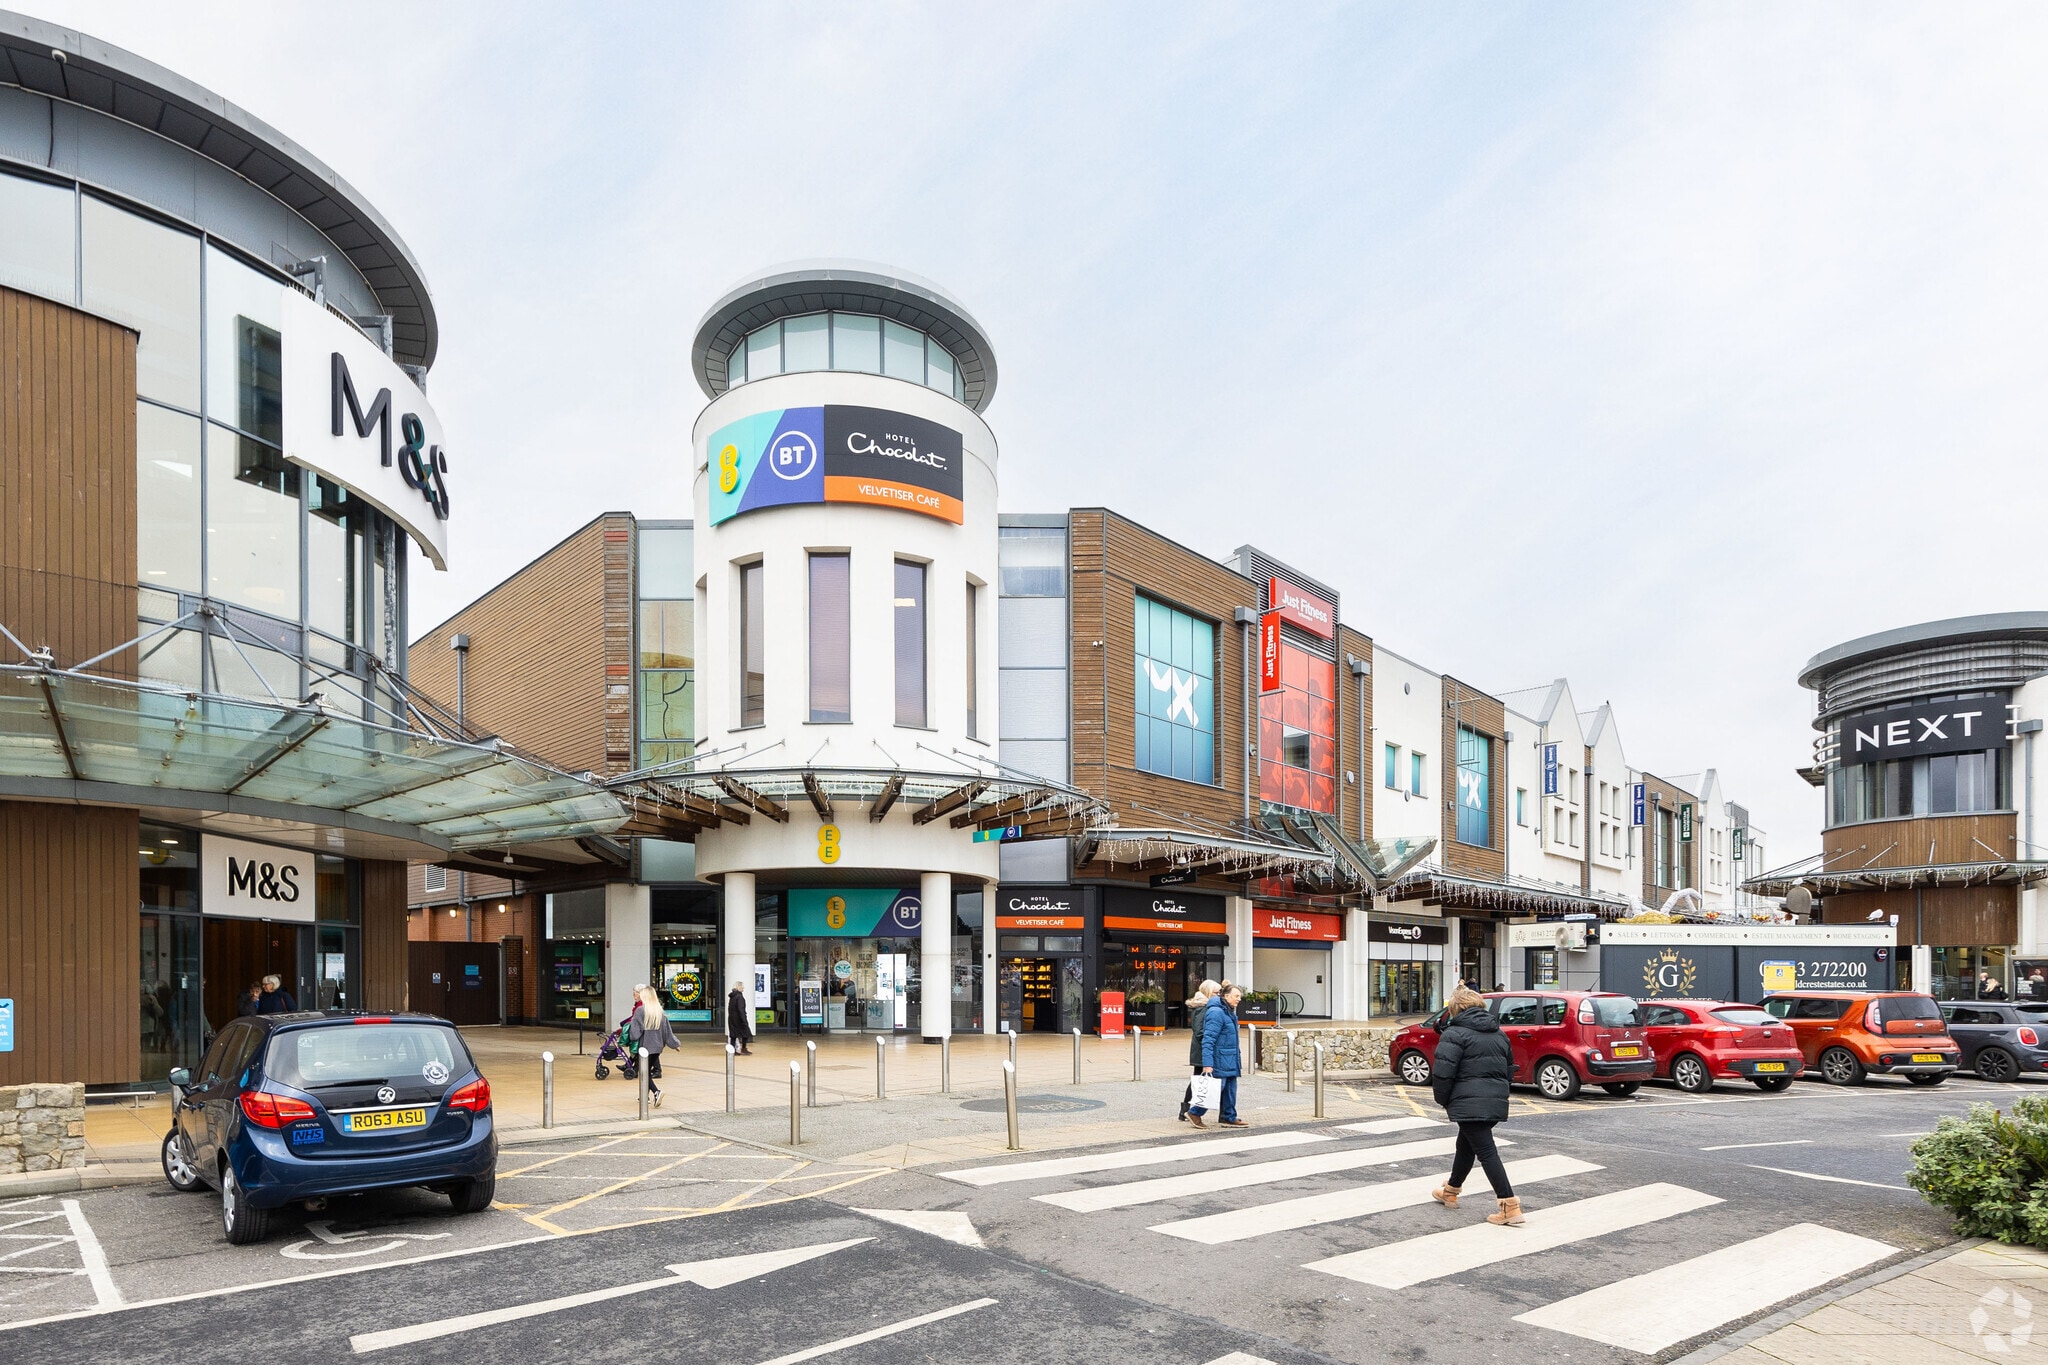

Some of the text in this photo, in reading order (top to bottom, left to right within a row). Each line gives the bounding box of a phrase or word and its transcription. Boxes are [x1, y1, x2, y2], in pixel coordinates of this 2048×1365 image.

[331, 352, 449, 520] M&S
[885, 433, 915, 445] HOTEL
[780, 446, 805, 465] BT
[858, 484, 940, 508] VELVETISER CAFÉ
[1281, 590, 1300, 610] Just
[1300, 598, 1328, 623] Fitness
[1265, 625, 1274, 678] Just Fitness
[1855, 711, 1983, 751] NEXT
[227, 857, 299, 902] M&S
[900, 906, 918, 919] BT
[1048, 918, 1065, 926] CAFÉ
[1269, 915, 1312, 930] Just Fitness
[673, 972, 698, 982] PHONES
[1658, 964, 1680, 987] G
[1811, 962, 1867, 977] 272200
[677, 983, 694, 991] 2HR
[672, 990, 699, 1002] REPAIRED
[1102, 1006, 1123, 1014] SALE
[354, 1111, 423, 1128] RO63 ASU
[295, 1130, 322, 1141] NHS
